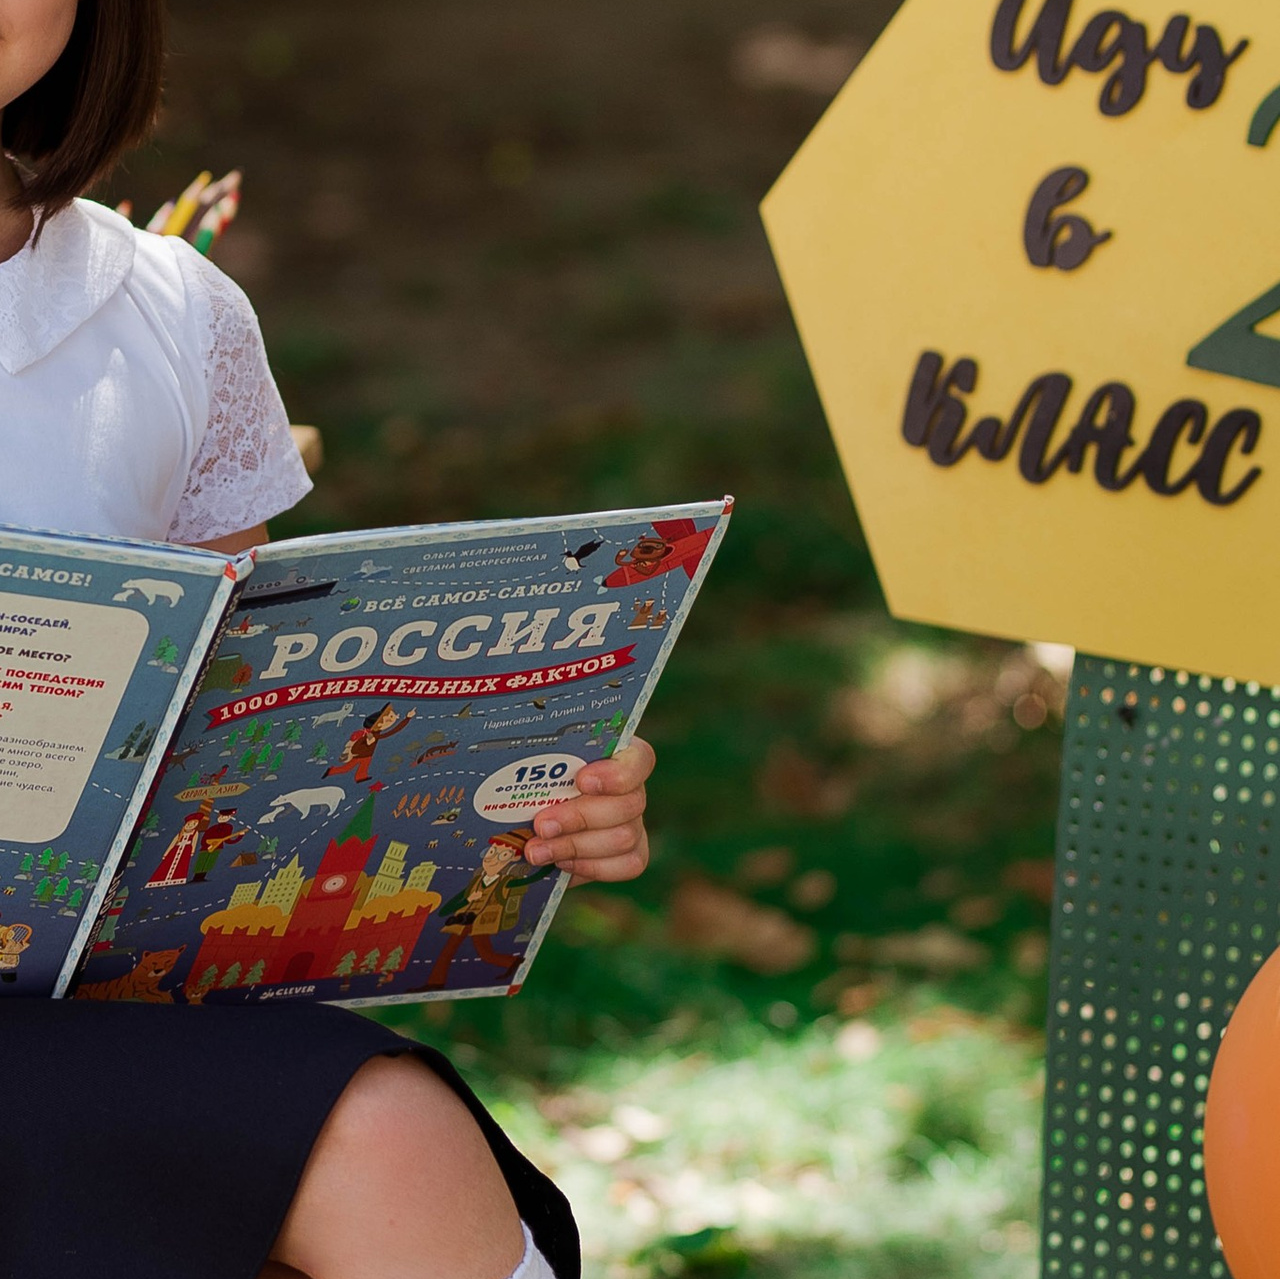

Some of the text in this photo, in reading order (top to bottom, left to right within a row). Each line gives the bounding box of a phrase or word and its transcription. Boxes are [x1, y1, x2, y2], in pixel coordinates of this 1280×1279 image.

[422, 543, 537, 561] ОЛЬГА ЖЕЛЕЗНИКОВА
[402, 553, 548, 575] СВЕТЛАНА ВОСКРЕСЕНСКАЯ
[362, 579, 582, 613] ВСЁ САМОЕ-САМОЕ!
[259, 601, 621, 680] РОССИЯ
[17, 648, 72, 663] МЕСТО?
[5, 668, 105, 689] ПОСЛЕДСТВИЯ
[220, 653, 617, 720] 1000 УДИВИТЕЛЬНЫХ ФАКТОВ
[29, 684, 85, 699] ТЕЛОМ?
[483, 694, 622, 730] Нарисовала Алина Рубан
[6, 748, 43, 758] много
[44, 752, 76, 762] всего
[515, 762, 568, 783] 150
[495, 778, 575, 793] ФОТОГРАФИЙ
[511, 791, 551, 800] КАРТЫ
[275, 985, 316, 996] CLEVER
